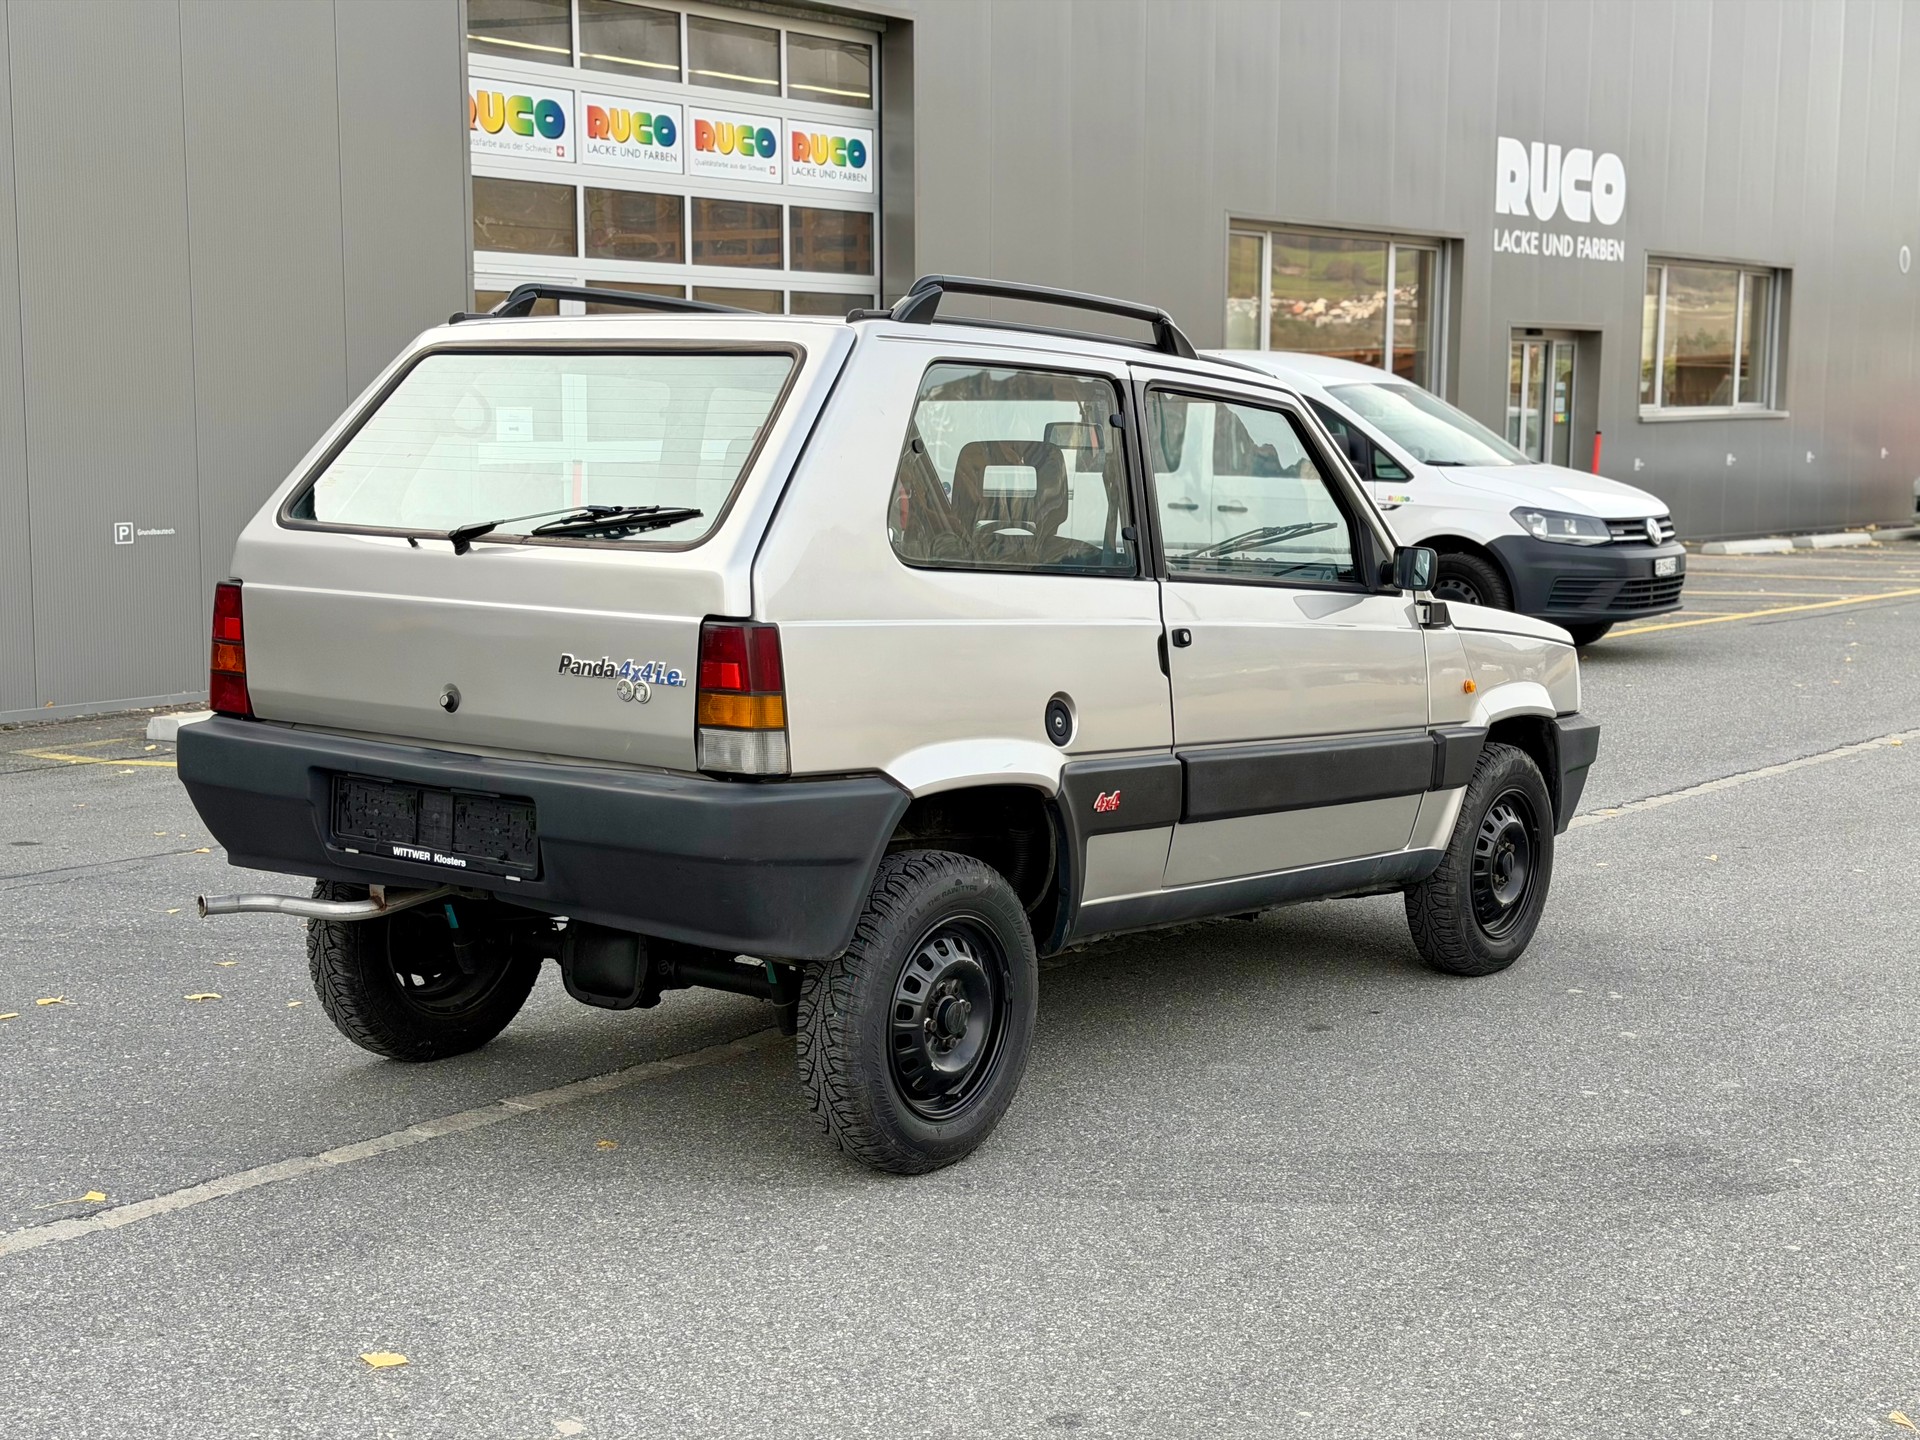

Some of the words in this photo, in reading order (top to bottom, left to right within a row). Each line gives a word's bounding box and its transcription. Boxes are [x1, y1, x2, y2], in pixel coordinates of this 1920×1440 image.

[587, 105, 676, 147] RUCO
[512, 141, 524, 150] der
[524, 143, 553, 154] Schweiz
[694, 119, 777, 159] RUCO
[791, 131, 867, 169] RUCO
[586, 143, 617, 157] LACKE
[619, 145, 641, 159] UND
[643, 149, 678, 162] FARBEN
[791, 166, 817, 178] LACKE
[818, 169, 837, 180] UND
[838, 171, 868, 183] FARBEN
[1495, 136, 1626, 226] RUCO
[1494, 228, 1539, 255] LACKE
[1542, 232, 1574, 258] UND
[1576, 235, 1625, 262] FARBEN
[119, 526, 129, 540] P
[558, 653, 617, 679] Panda
[1093, 790, 1121, 813] 4x4
[393, 847, 430, 861] WITTWER
[434, 854, 466, 867] Klosters
